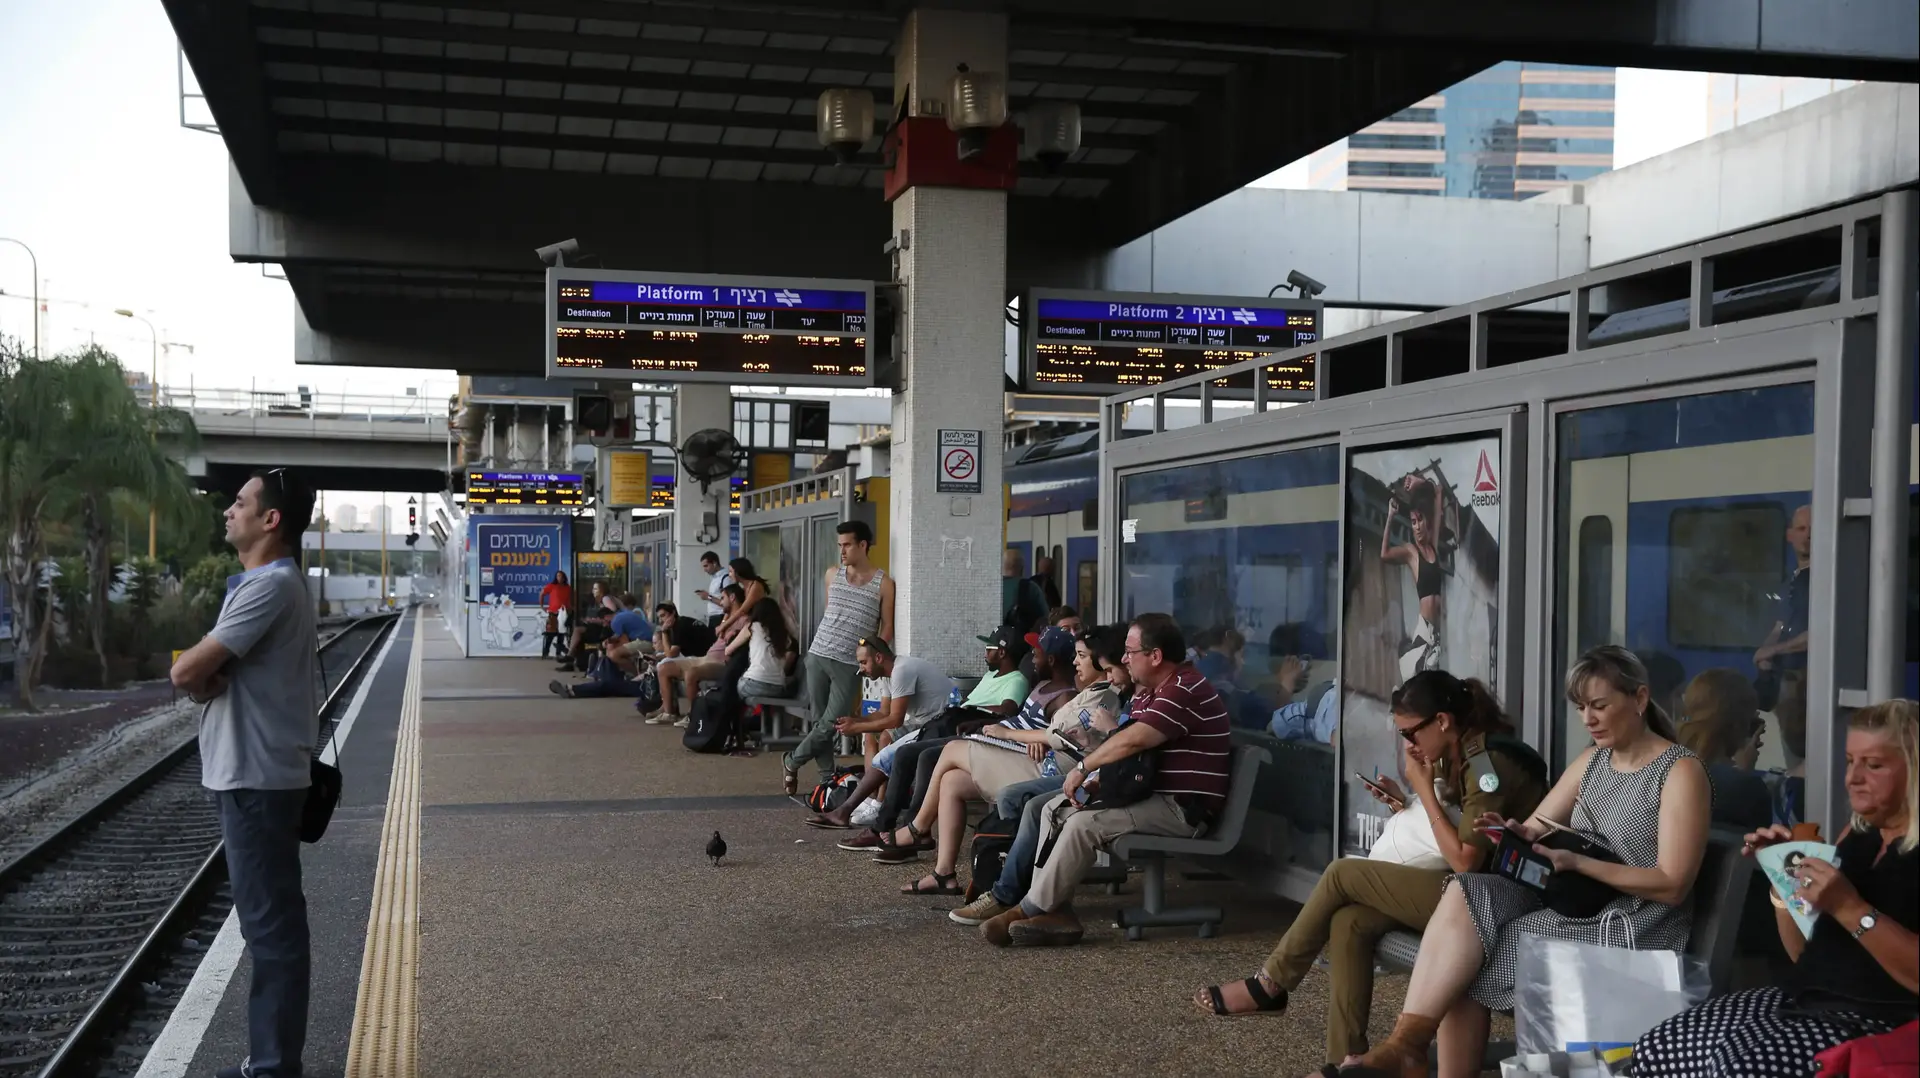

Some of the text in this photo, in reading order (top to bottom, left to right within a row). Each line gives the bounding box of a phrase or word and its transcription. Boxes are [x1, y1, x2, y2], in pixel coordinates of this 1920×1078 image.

[637, 285, 719, 301] Platform 1
[730, 288, 766, 306] רציף
[567, 308, 611, 318] Destination
[639, 311, 694, 322] תחנות ביניים
[706, 310, 735, 321] מעודכן
[746, 312, 766, 320] שעה
[1109, 304, 1184, 319] Platform 2
[1193, 307, 1225, 323] רציף
[801, 317, 815, 326] יעד
[846, 315, 866, 324] רכבת
[747, 321, 765, 330] Time
[1046, 325, 1085, 335] Destination
[1111, 329, 1160, 339] תחנות ביניים
[1171, 328, 1197, 338] מעודכן
[1207, 328, 1225, 337] שעה
[1297, 332, 1316, 341] רכבת
[1208, 338, 1225, 346] Time
[1257, 334, 1270, 343] יעד
[490, 533, 551, 549] משדרגים
[490, 548, 551, 567] למענכם
[1356, 812, 1381, 850] THE
